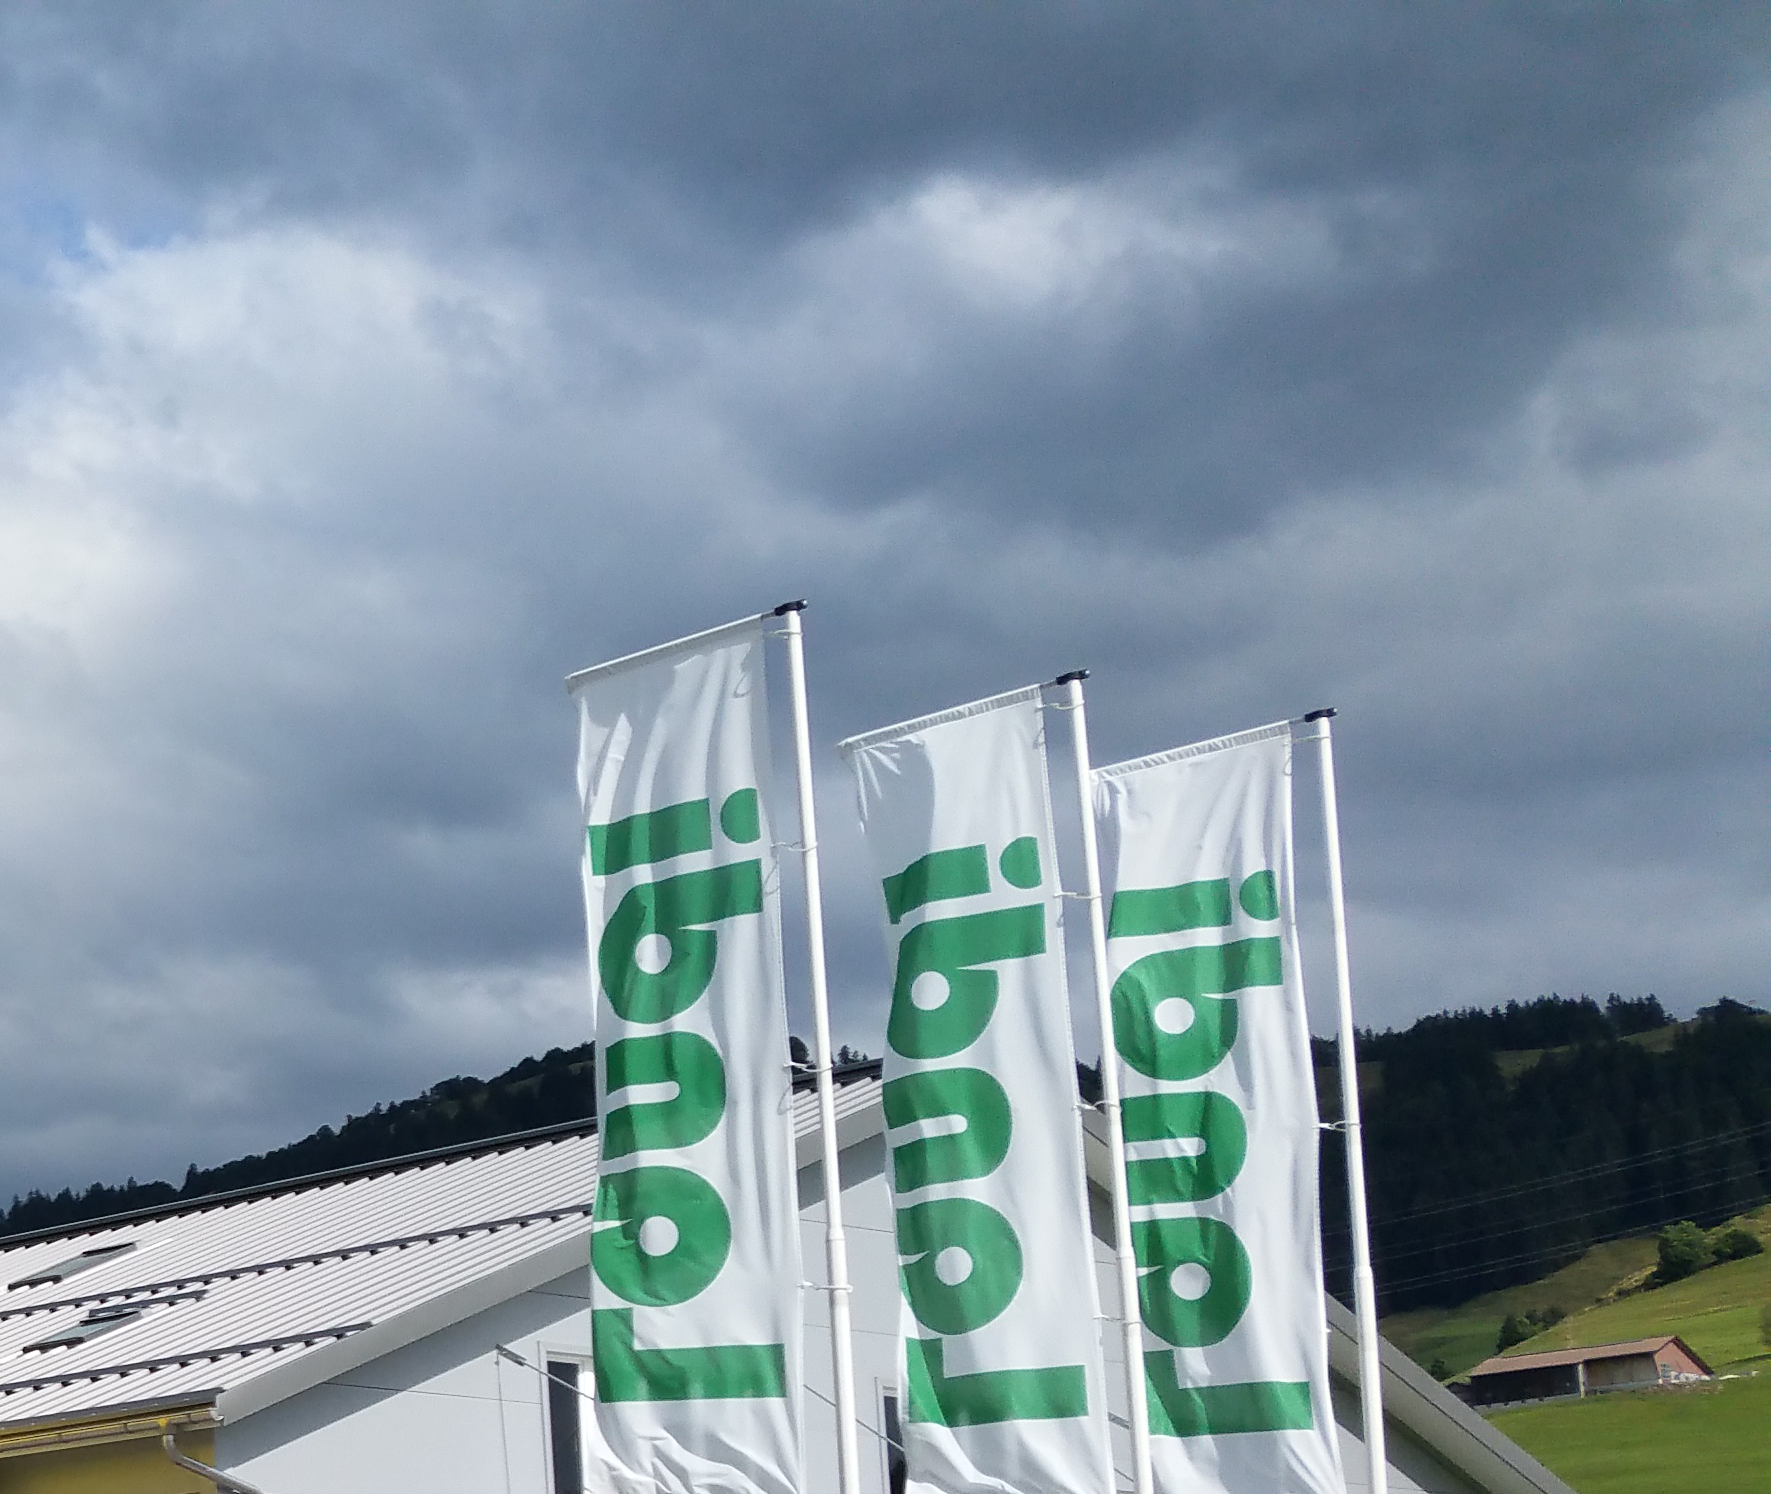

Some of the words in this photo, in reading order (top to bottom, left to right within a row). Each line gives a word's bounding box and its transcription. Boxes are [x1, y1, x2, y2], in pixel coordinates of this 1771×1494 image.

[588, 788, 786, 1404] Landi
[882, 836, 1088, 1428] Landi
[1108, 869, 1314, 1437] Landi
